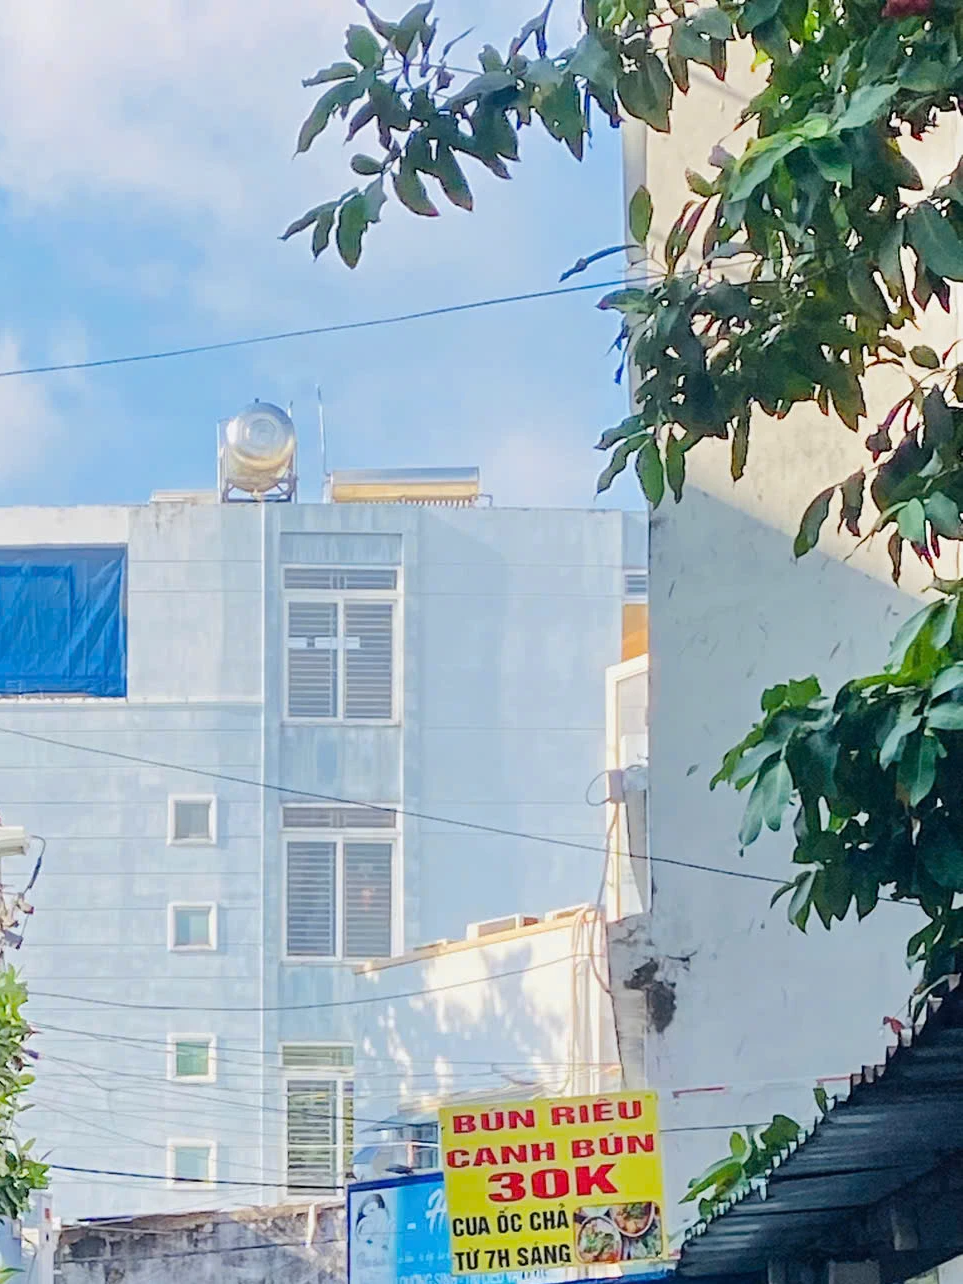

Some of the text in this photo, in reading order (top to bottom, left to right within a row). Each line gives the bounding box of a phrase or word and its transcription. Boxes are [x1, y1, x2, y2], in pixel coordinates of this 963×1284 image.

[453, 1098, 642, 1134] BÚN RIÊU
[446, 1132, 654, 1168] CANH BÚN
[488, 1163, 618, 1203] 30K
[453, 1203, 570, 1237] CUA ỐC CHẢ
[454, 1246, 480, 1271] TỪ
[484, 1248, 510, 1269] 7H
[517, 1241, 572, 1267] SÁNG
